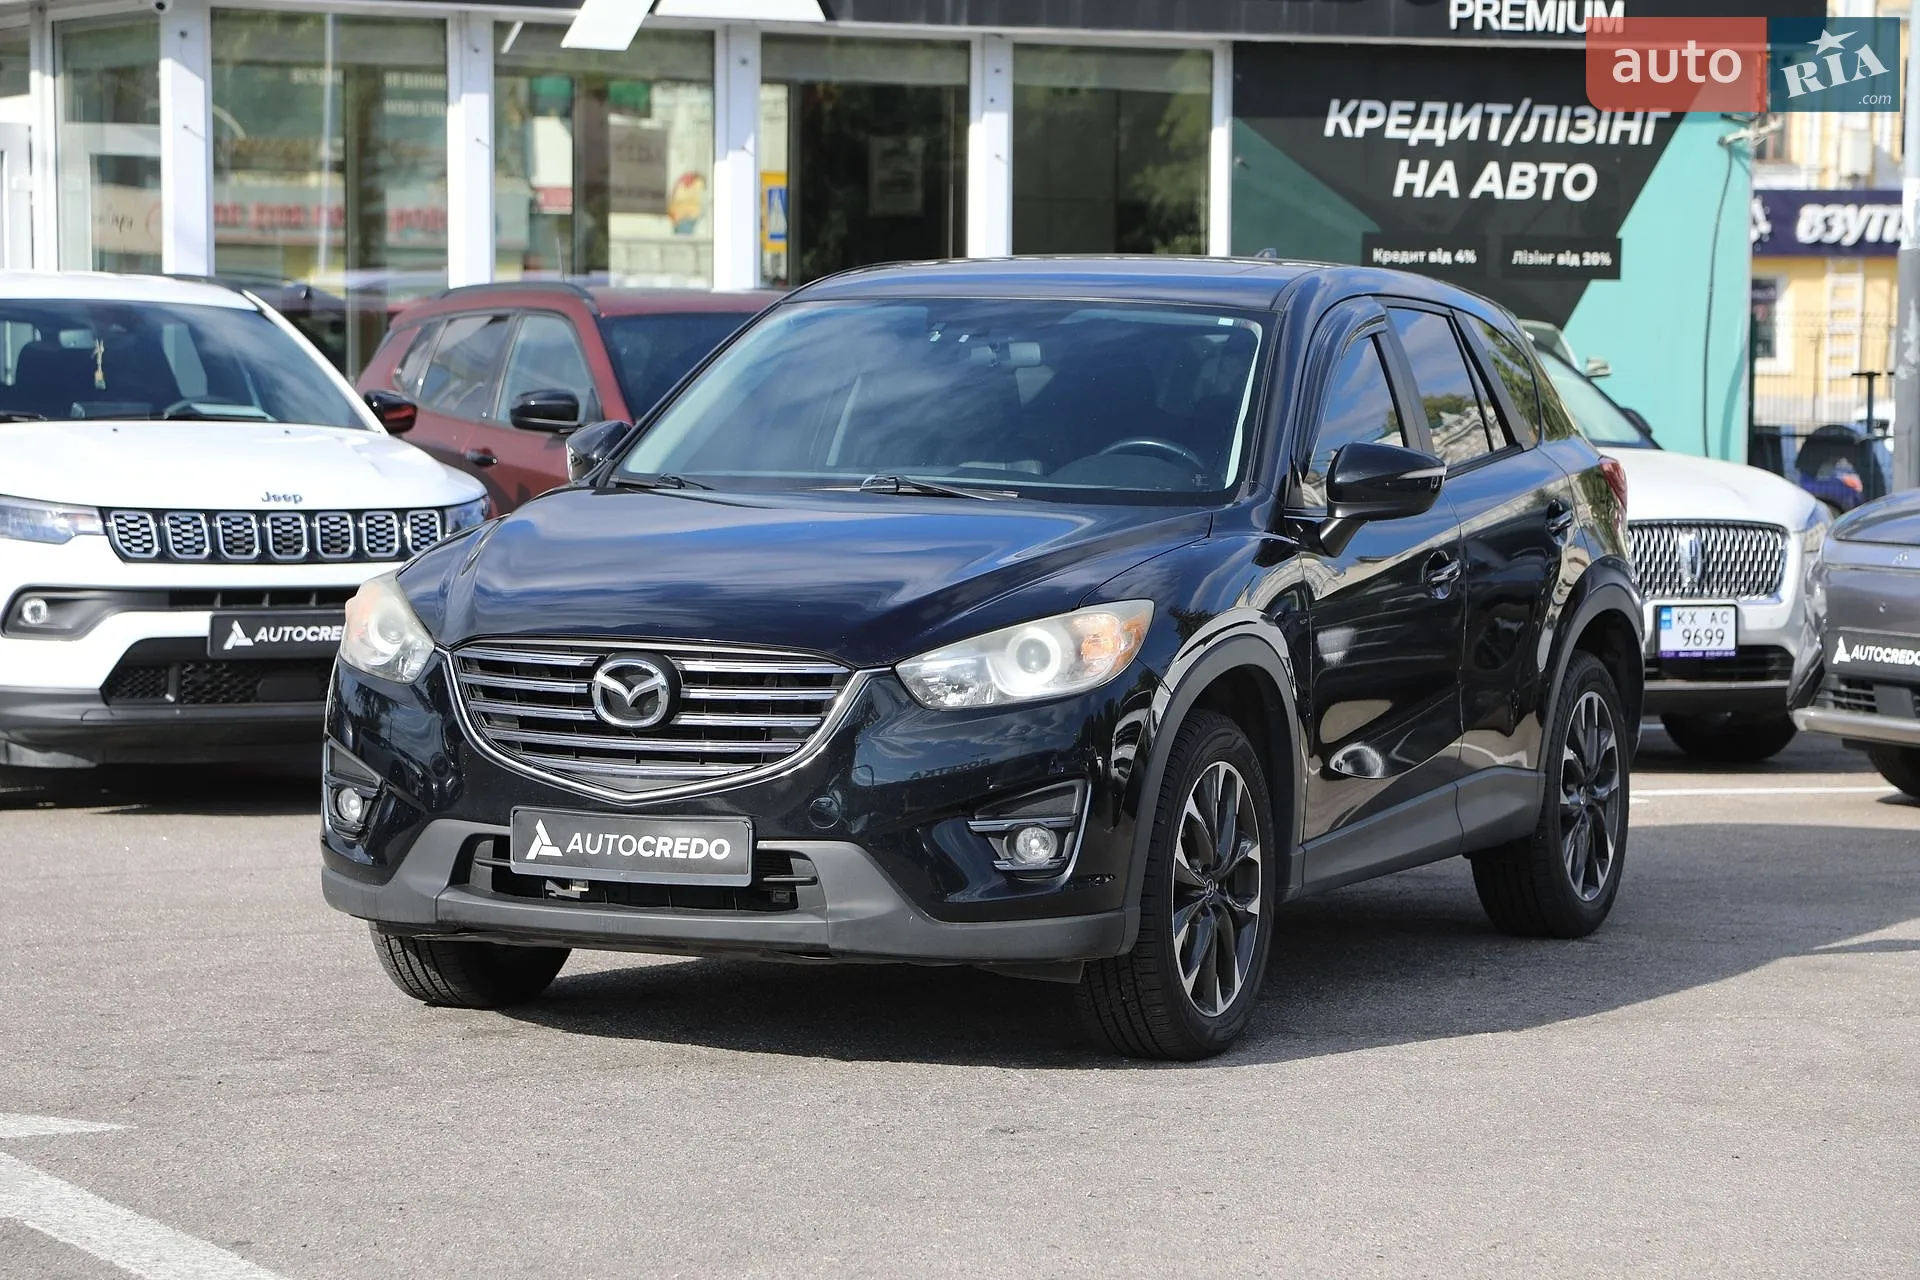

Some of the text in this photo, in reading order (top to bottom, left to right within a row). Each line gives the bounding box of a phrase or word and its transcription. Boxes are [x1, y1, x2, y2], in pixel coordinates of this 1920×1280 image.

[1449, 0, 1624, 33] PREMIUM
[1324, 98, 1671, 147] КРЕДИТ/ЛІЗІНГ
[1392, 159, 1599, 202] НА АВТО
[1796, 203, 1903, 246] ВЗУТТ
[1372, 248, 1477, 265] Кредит від 4%
[1511, 250, 1612, 267] Лізінг від 20%
[260, 491, 303, 504] Jeep
[1710, 611, 1729, 624] AC
[1681, 628, 1725, 647] 9699
[566, 832, 732, 860] AUTOCREDO
